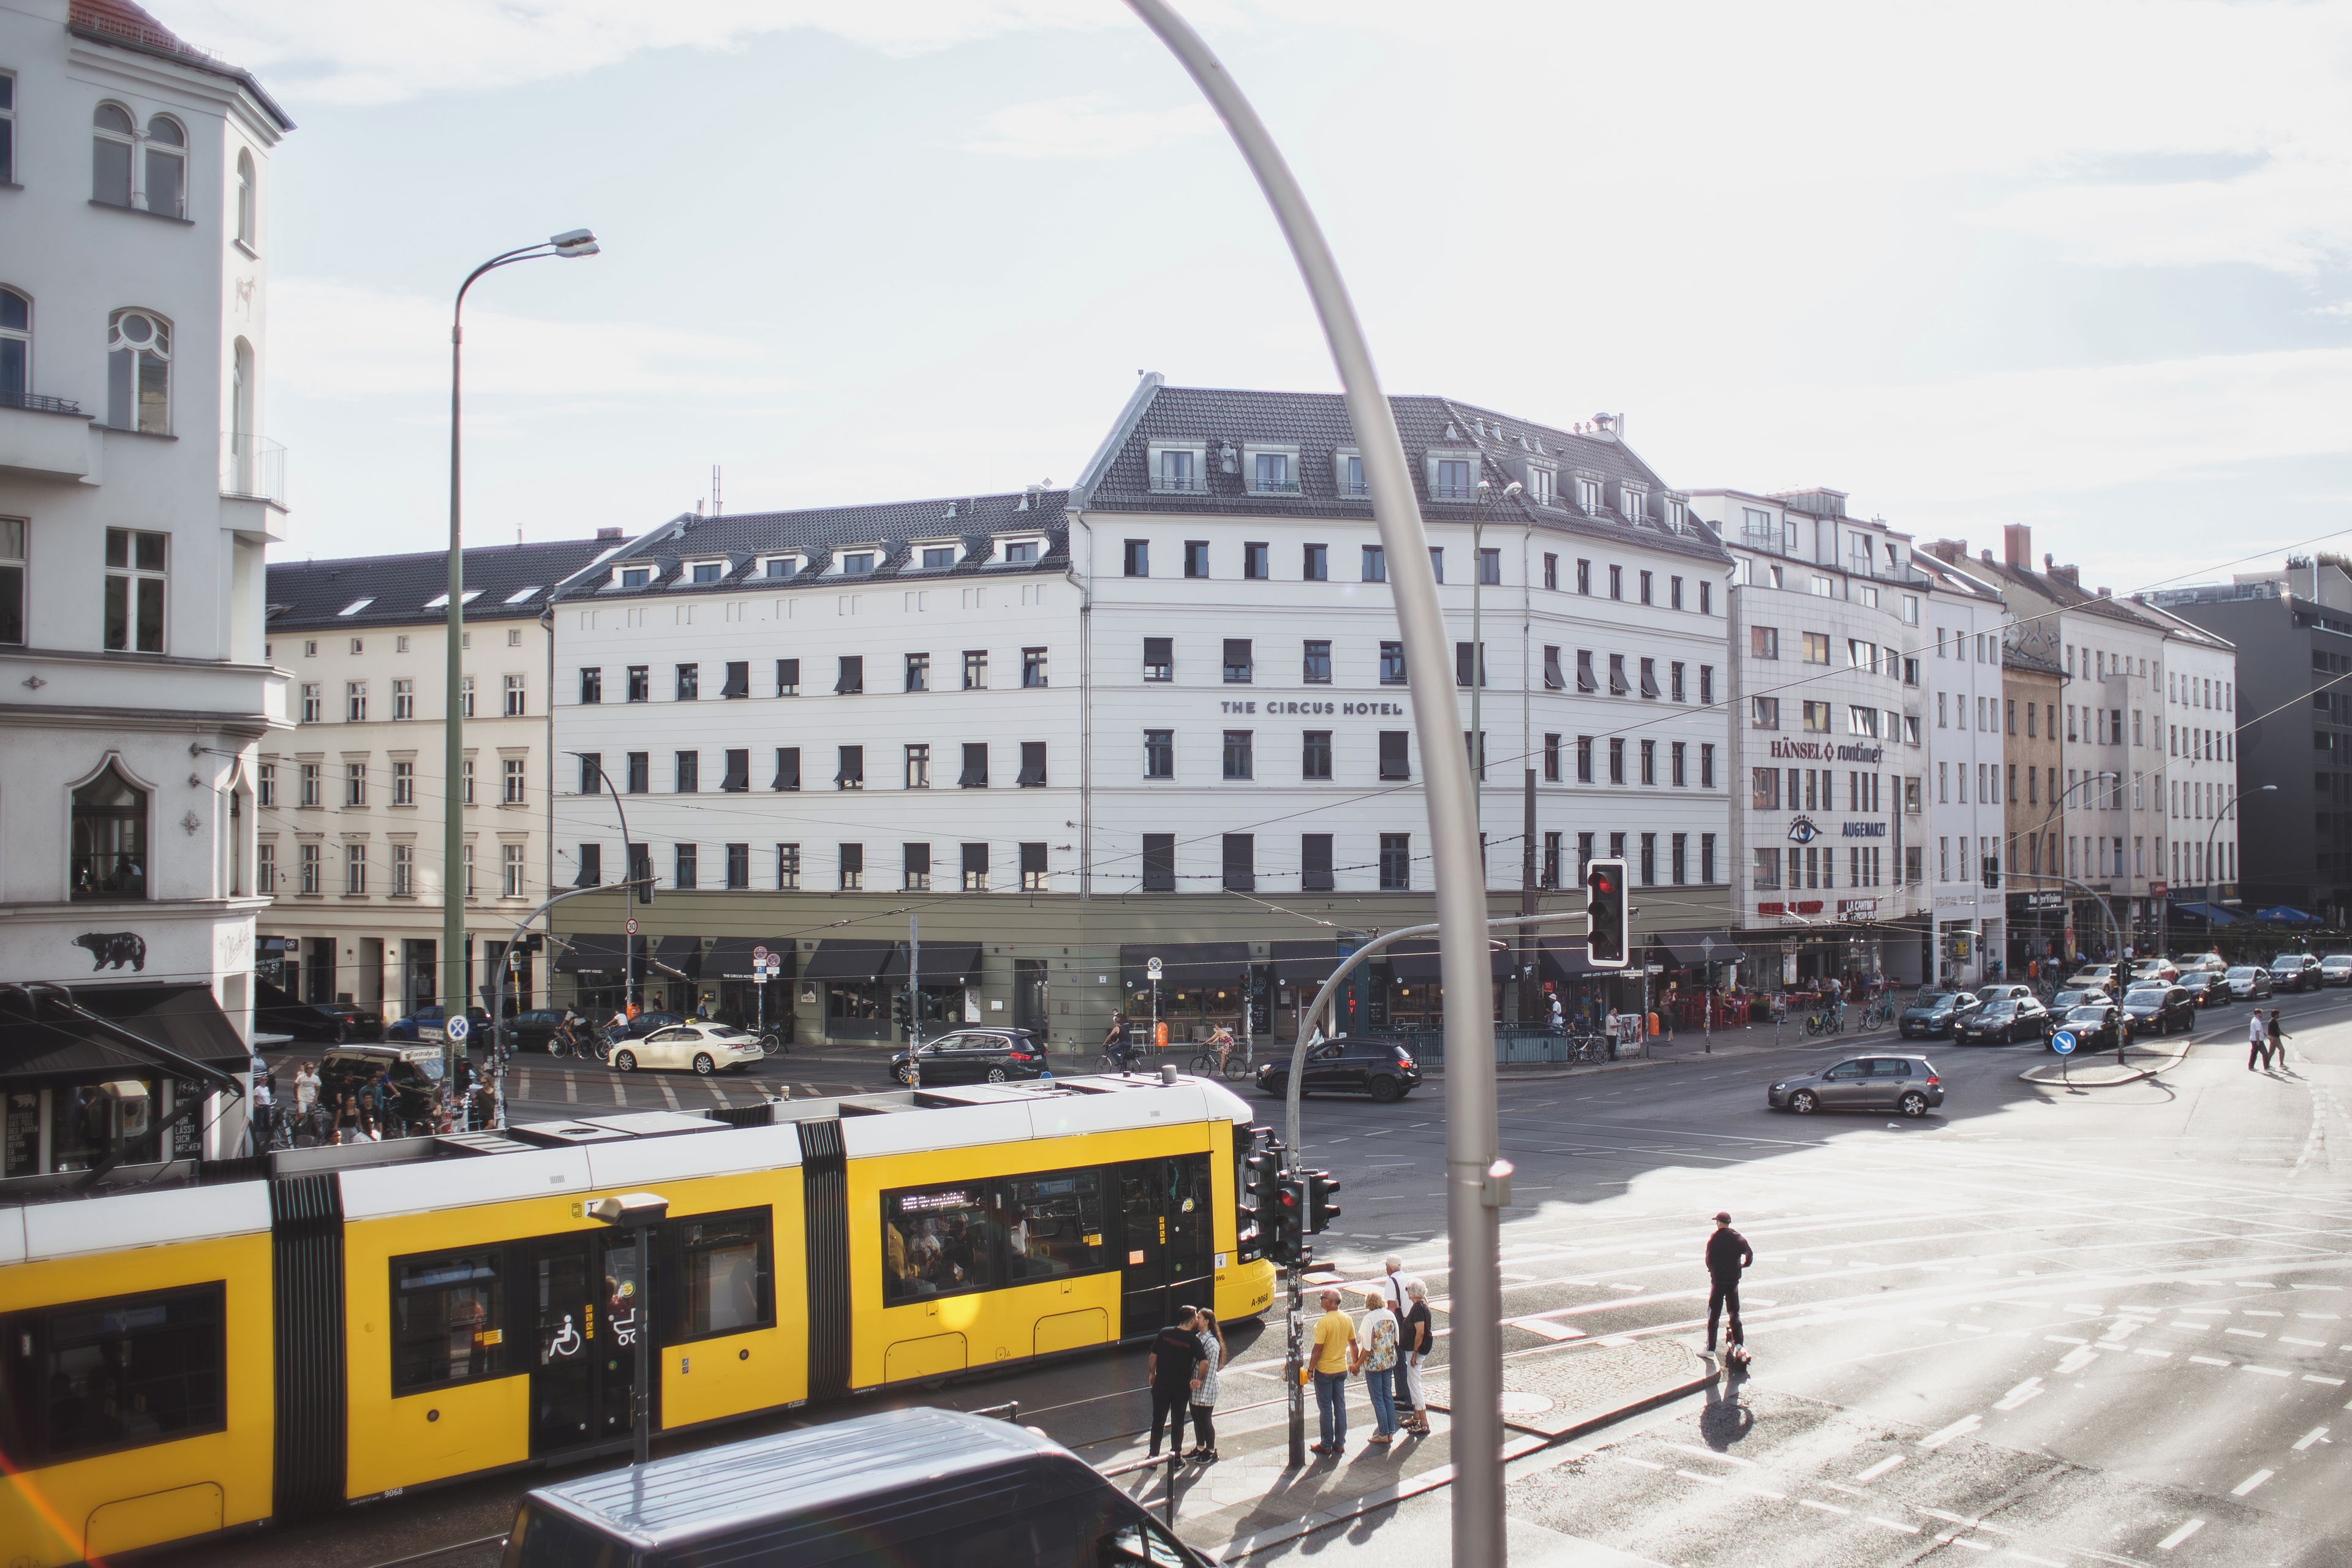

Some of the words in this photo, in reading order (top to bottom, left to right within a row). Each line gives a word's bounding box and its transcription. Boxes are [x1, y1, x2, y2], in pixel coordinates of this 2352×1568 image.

[1221, 701, 1256, 714] THE
[1267, 701, 1334, 715] CIRCUS
[1343, 702, 1403, 715] HOTEL
[1770, 737, 1823, 760] HÄNSEL
[1838, 742, 1878, 764] runtime
[1842, 822, 1886, 837] AUGENARZT
[2029, 893, 2062, 906] BugerVision
[176, 1125, 195, 1134] LÄSST
[176, 1134, 190, 1144] SICH
[1251, 1292, 1268, 1307] A-9068
[384, 1487, 403, 1498] 9068
